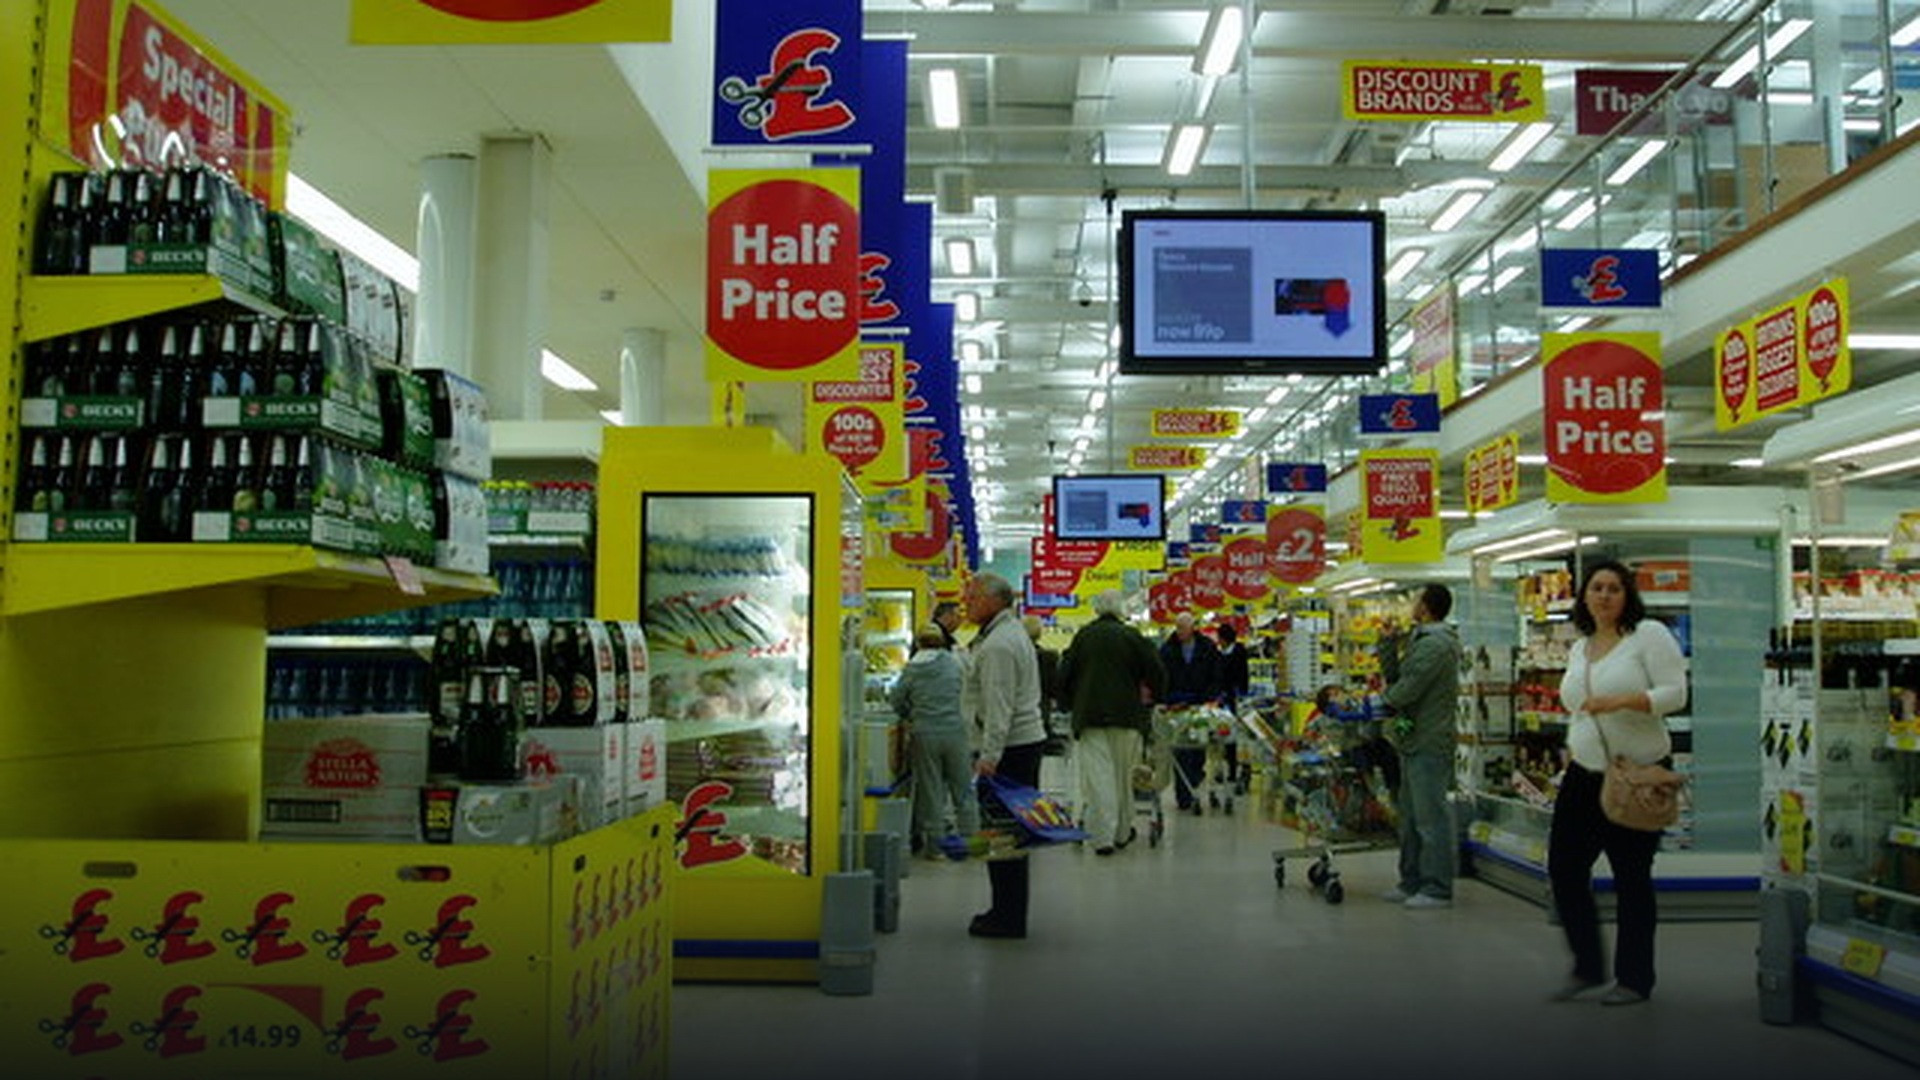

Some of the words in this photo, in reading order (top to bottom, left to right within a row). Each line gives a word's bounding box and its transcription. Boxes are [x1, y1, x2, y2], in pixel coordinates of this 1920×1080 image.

[142, 23, 237, 136] Special
[1358, 71, 1480, 92] DISCOUNT
[1358, 92, 1454, 111] BRANDS
[732, 223, 840, 265] Half
[721, 278, 847, 320] Price
[1563, 376, 1648, 410] Half
[833, 413, 875, 431] 100s
[1556, 421, 1655, 455] Price
[1372, 495, 1428, 506] QUALITY
[1276, 528, 1314, 561] £2
[316, 758, 368, 769] STELLA
[316, 771, 369, 782] ARTOIS
